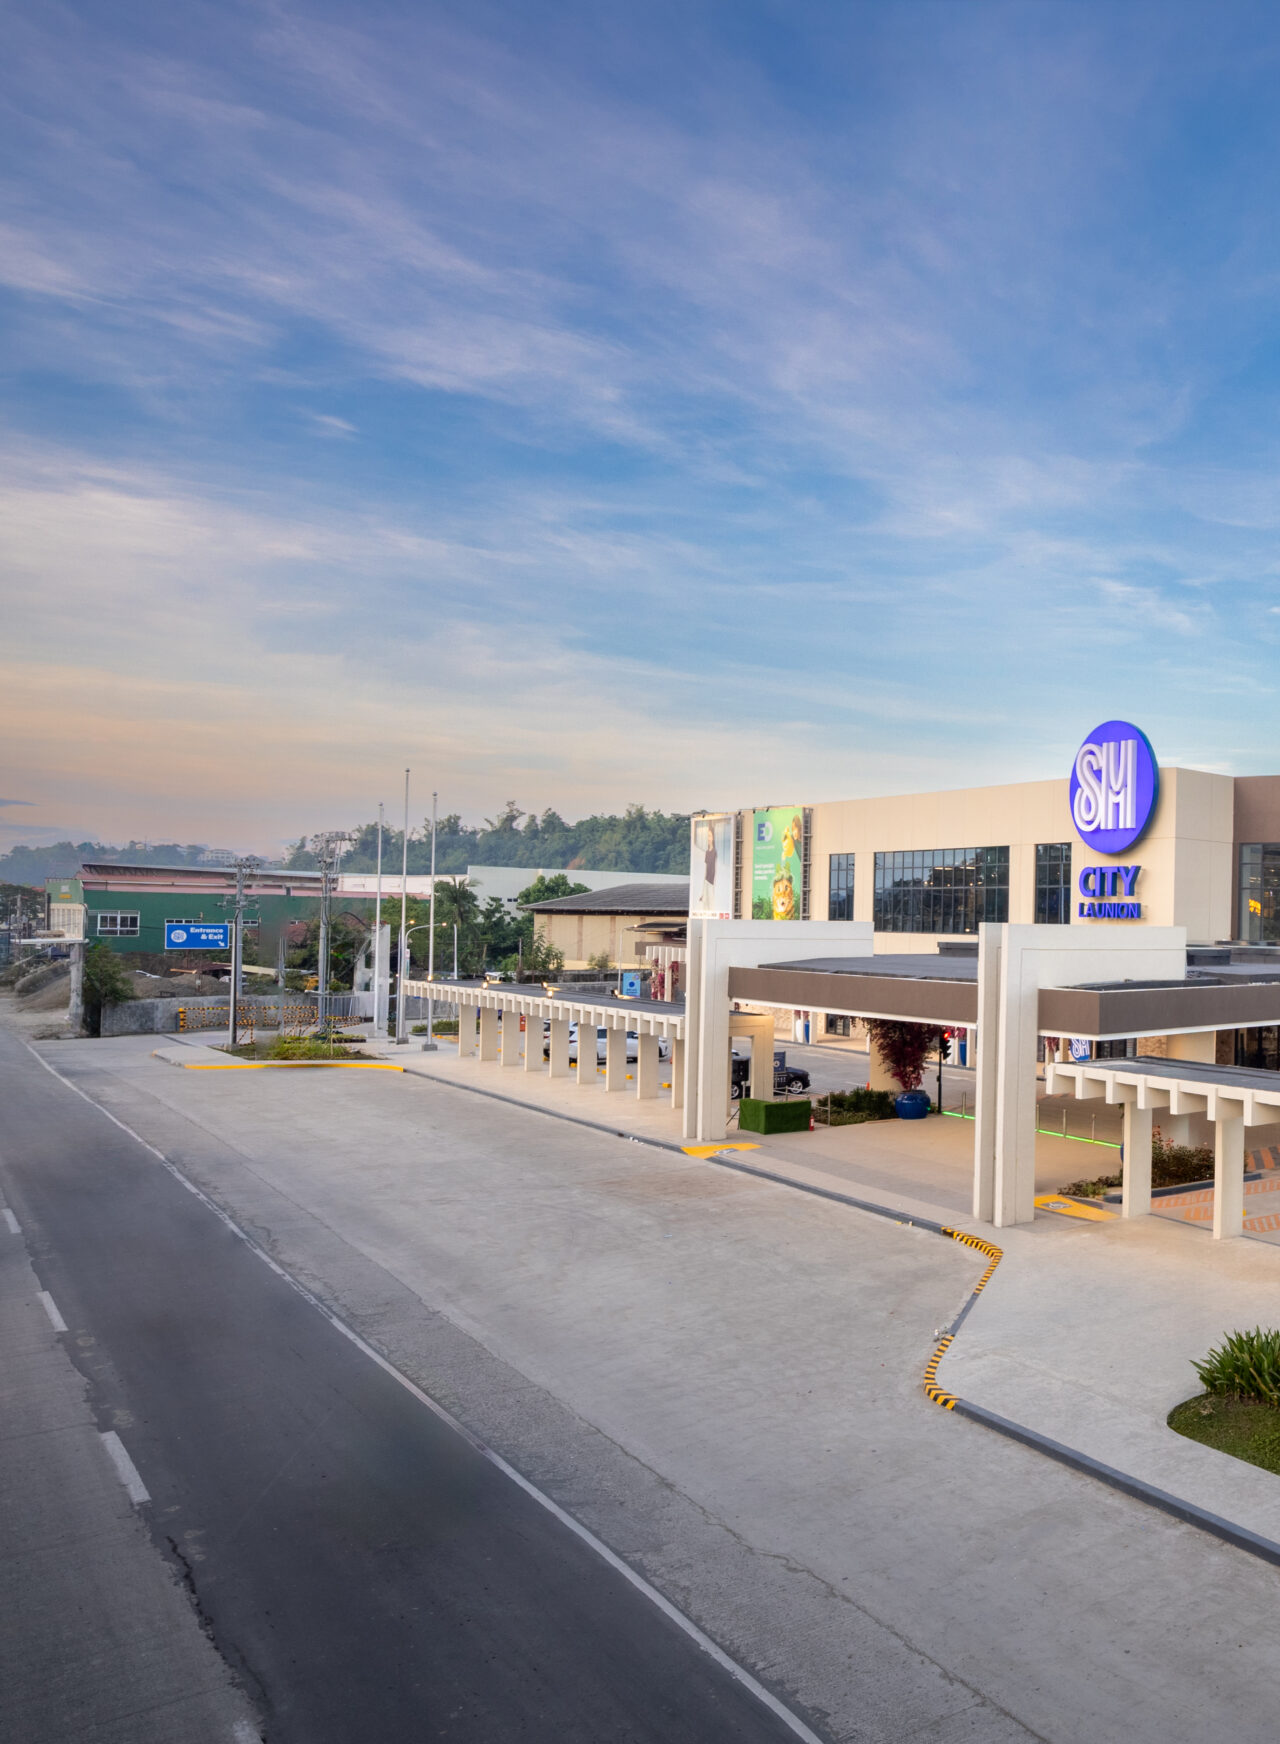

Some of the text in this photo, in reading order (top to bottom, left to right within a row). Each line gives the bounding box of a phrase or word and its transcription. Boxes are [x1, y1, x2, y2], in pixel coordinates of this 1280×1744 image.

[1074, 739, 1138, 832] SM
[1079, 865, 1141, 898] CITY
[1078, 903, 1141, 919] LA UNION
